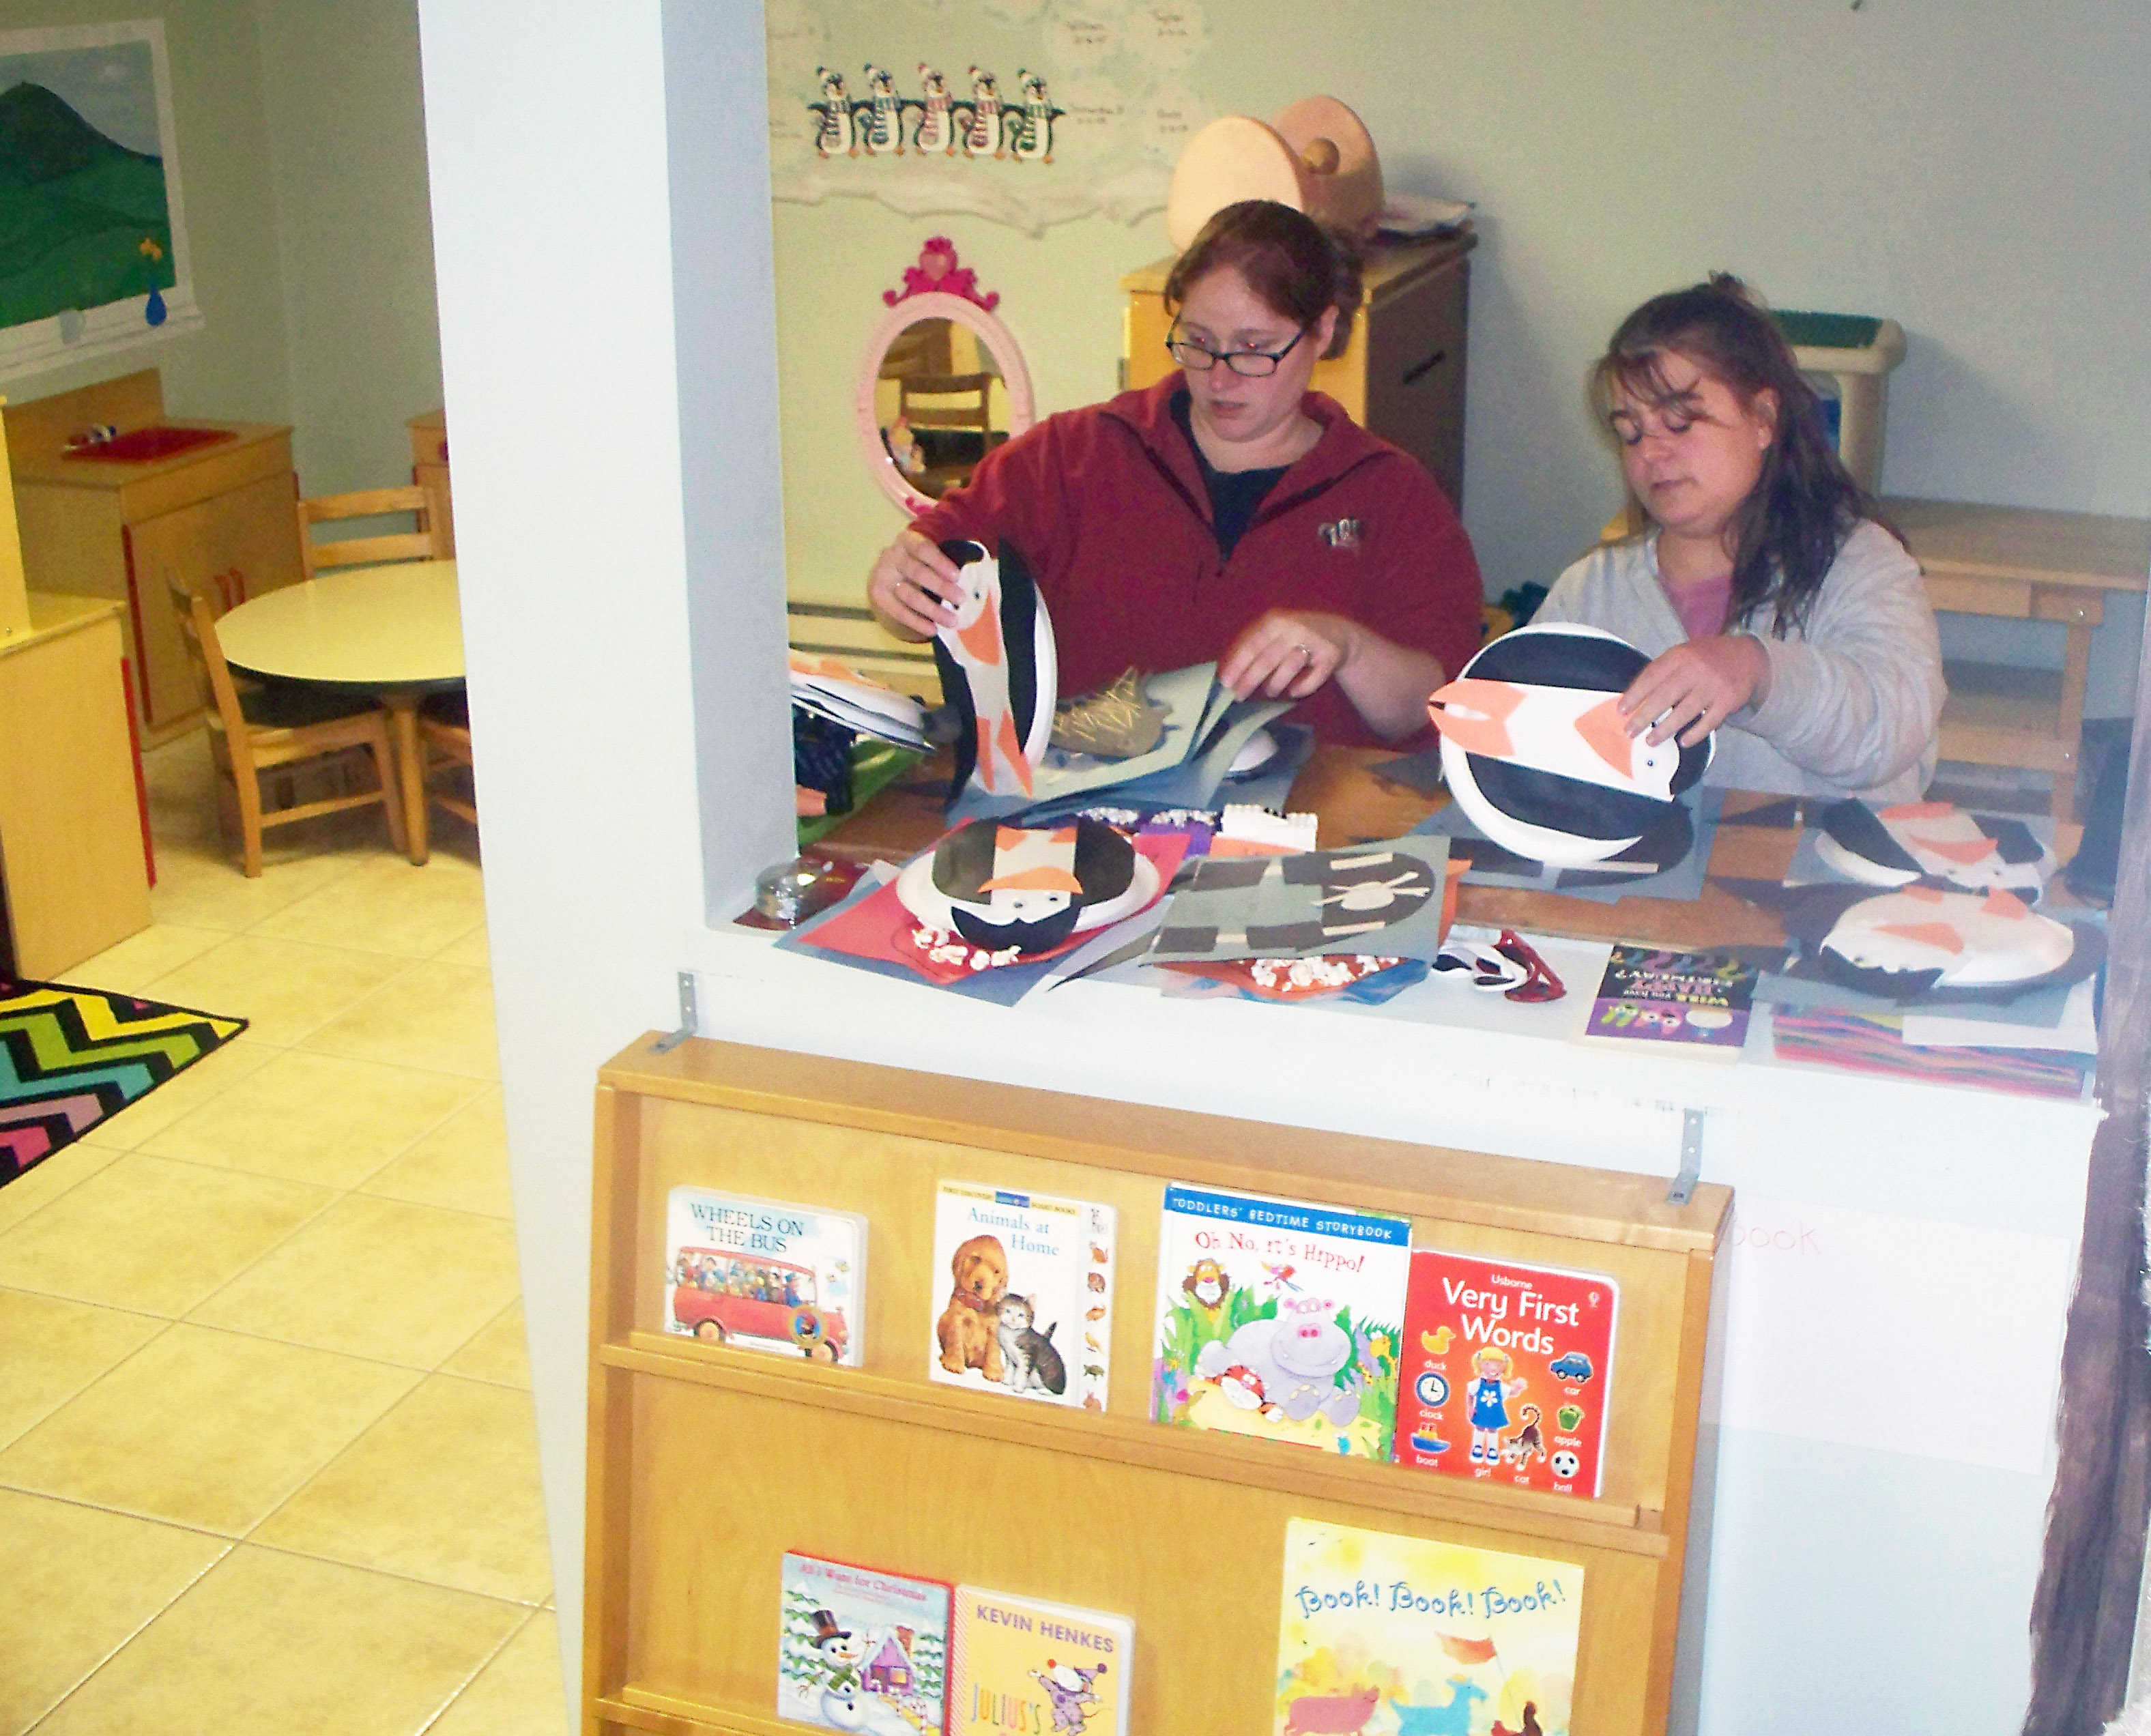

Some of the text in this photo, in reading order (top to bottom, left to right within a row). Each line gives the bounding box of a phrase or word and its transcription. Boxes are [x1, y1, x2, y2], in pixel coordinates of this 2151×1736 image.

[691, 1203, 805, 1236] WHEELS ON
[968, 1207, 1050, 1234] Animals at
[1249, 1209, 1310, 1228] BEDTIME
[1316, 1220, 1393, 1240] STORYBOOK
[707, 1226, 787, 1252] THE BUS
[1012, 1234, 1059, 1256] Home
[1491, 1273, 1533, 1290] Usborne
[1443, 1277, 1580, 1327] Very First
[1461, 1314, 1555, 1355] Words
[1419, 1409, 1444, 1421] clock
[1295, 1578, 1566, 1619] Book! Book! Book!
[977, 1604, 1114, 1654] KEVIN HENKES
